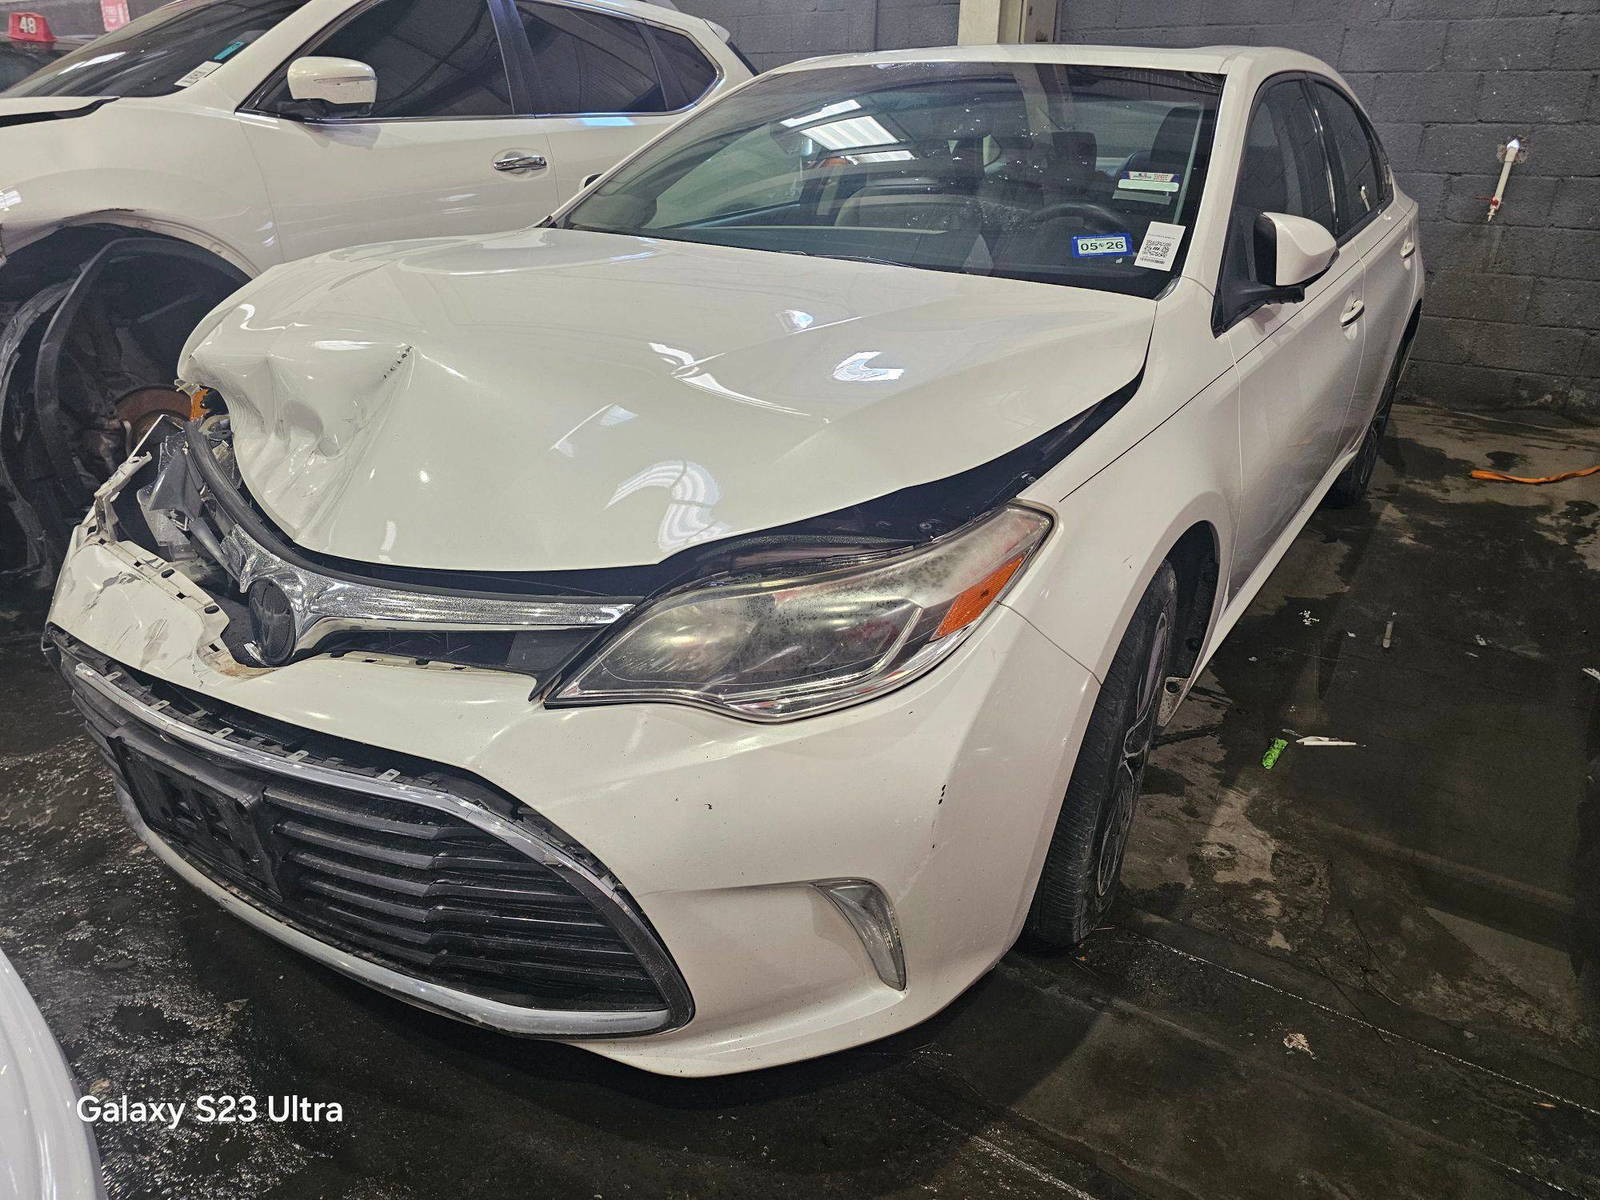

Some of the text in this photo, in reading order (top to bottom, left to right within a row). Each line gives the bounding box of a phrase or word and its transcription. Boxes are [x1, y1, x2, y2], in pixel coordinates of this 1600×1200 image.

[20, 16, 37, 34] 48
[1080, 241, 1124, 251] 05 26
